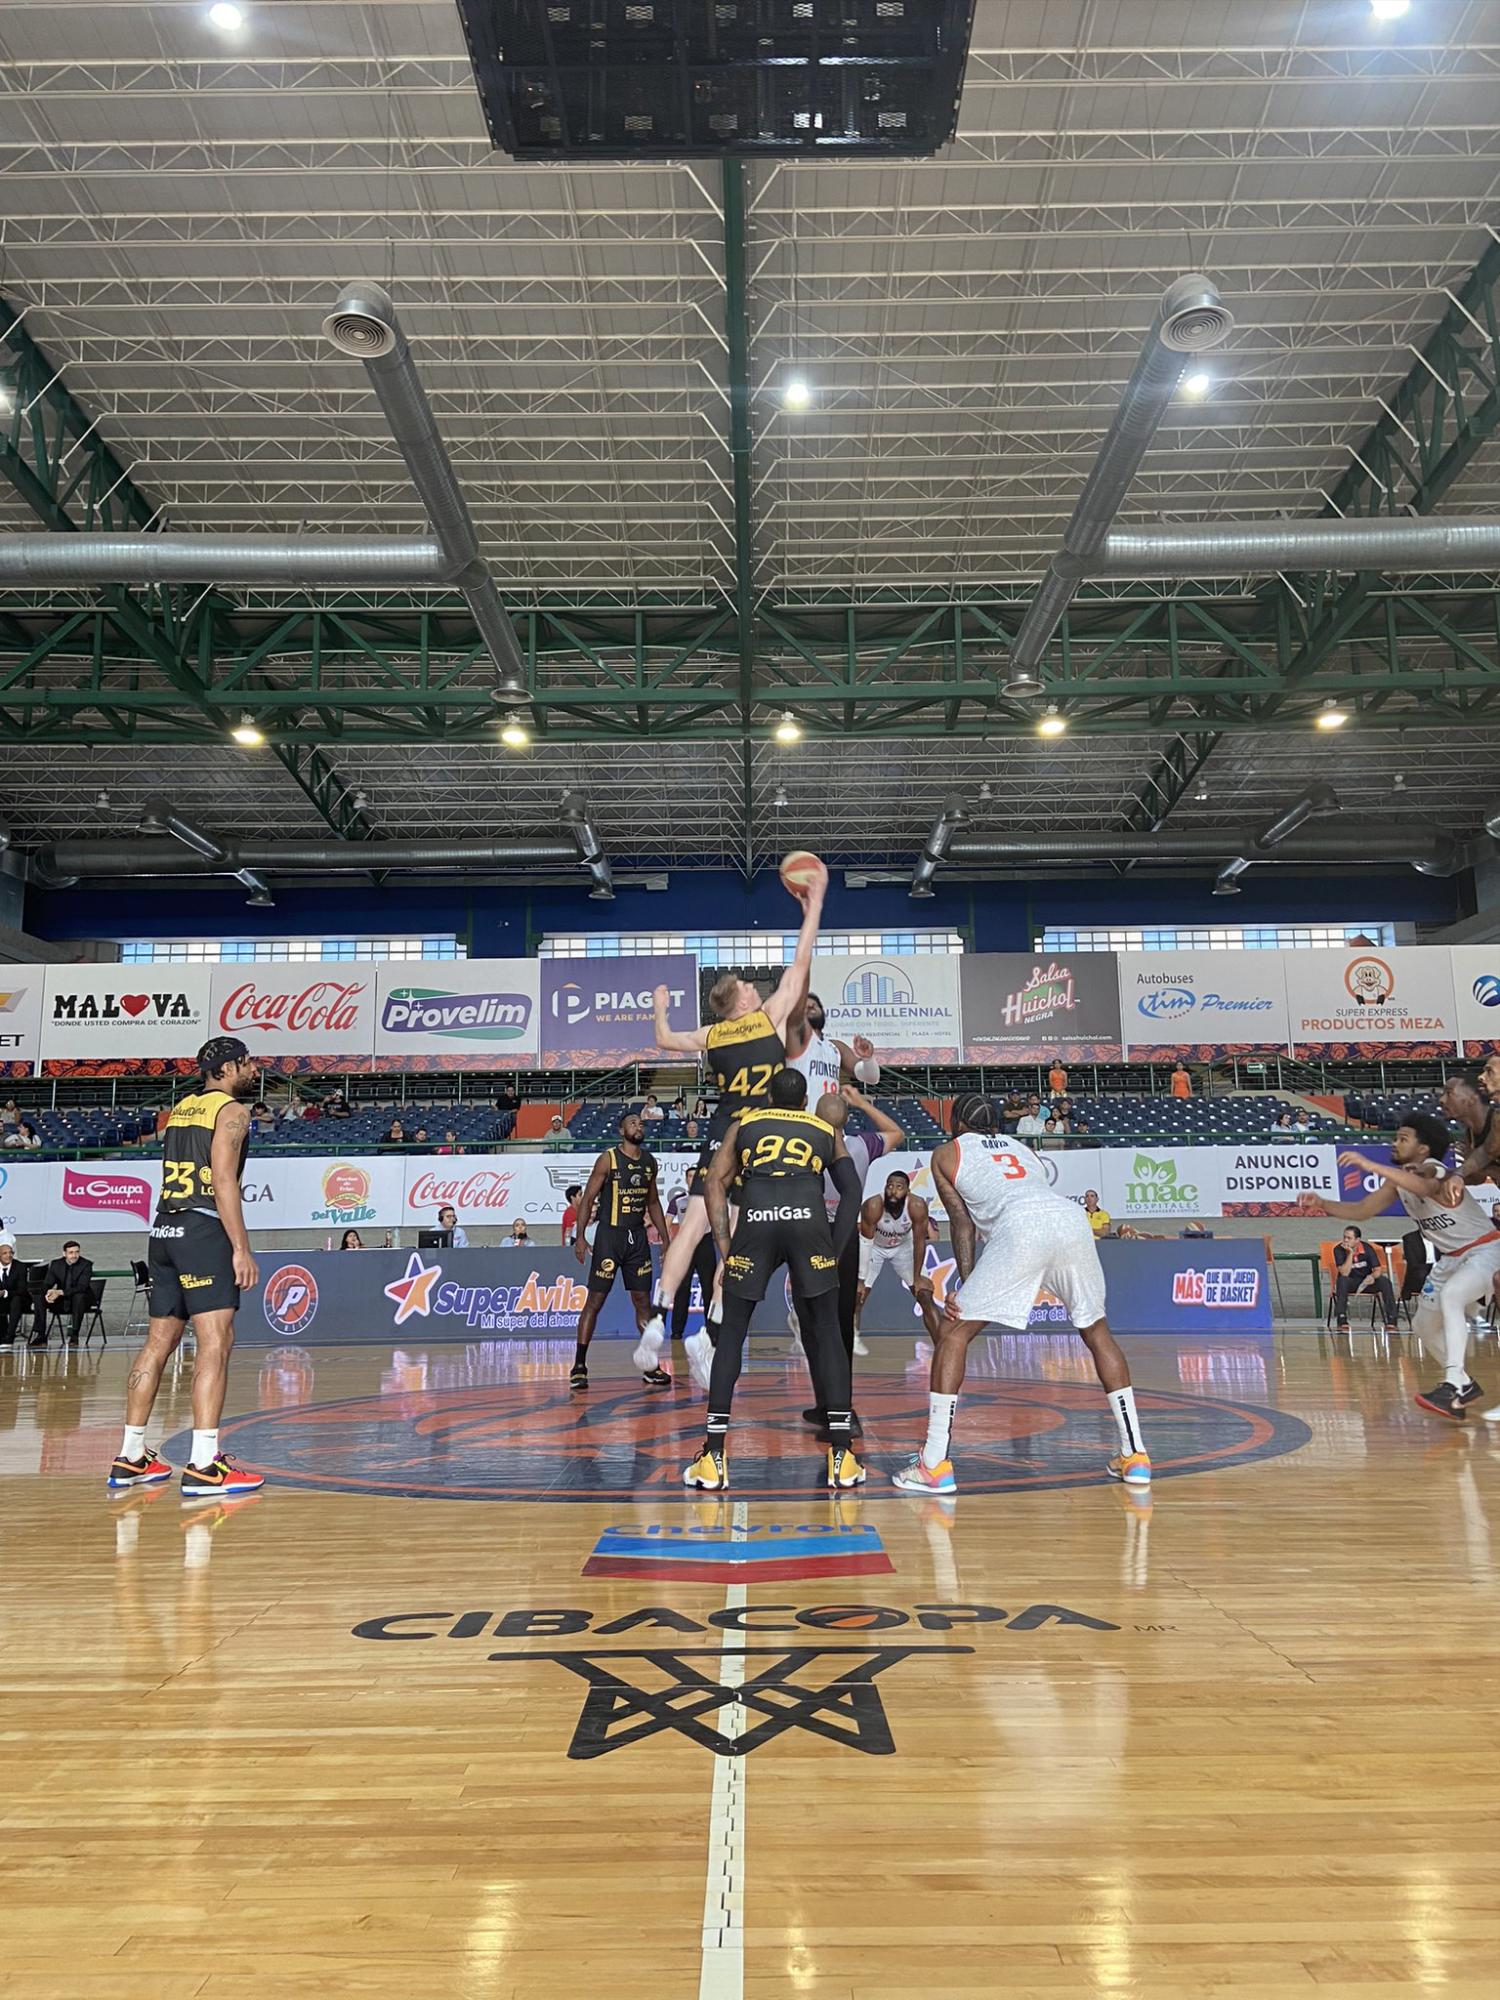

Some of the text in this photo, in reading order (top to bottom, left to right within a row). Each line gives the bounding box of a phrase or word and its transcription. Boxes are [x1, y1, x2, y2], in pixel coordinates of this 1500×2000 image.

[1023, 962, 1071, 991] Salsa
[1137, 973, 1194, 984] Autobuses
[595, 990, 685, 1009] PIAGT
[1001, 979, 1075, 1026] Huichol
[1200, 993, 1273, 1011] Premier
[386, 998, 525, 1028] Provelim
[596, 1014, 611, 1022] WE
[614, 1014, 633, 1022] ARE
[866, 1007, 952, 1018] MILLENNIAL
[1023, 1011, 1054, 1024] NEGRA
[1335, 1008, 1408, 1017] SUPER EXPRESS
[1301, 1018, 1445, 1031] PRODUCTOS MEZA
[728, 1063, 772, 1097] 42
[752, 1135, 813, 1168] 99
[991, 1153, 1027, 1180] 3
[1235, 1155, 1319, 1169] ANUNCIO
[163, 1160, 196, 1199] 23
[1226, 1176, 1332, 1190] DISPONIBLE
[68, 1180, 143, 1198] La Guapa
[747, 1205, 812, 1223] SoniGas
[1125, 1201, 1200, 1210] HOSPITALES
[311, 1206, 377, 1225] Del Valle
[1175, 1270, 1205, 1300] MÁS
[1206, 1271, 1256, 1284] QUE UN JUEGO
[1206, 1286, 1255, 1302] DE BASKET
[481, 1314, 495, 1328] Mi
[530, 1313, 547, 1327] del
[550, 1313, 578, 1327] ahorr
[1050, 1306, 1067, 1321] del
[602, 1524, 878, 1535] Chevron
[351, 1604, 1179, 1641] CIBACOPA MR
